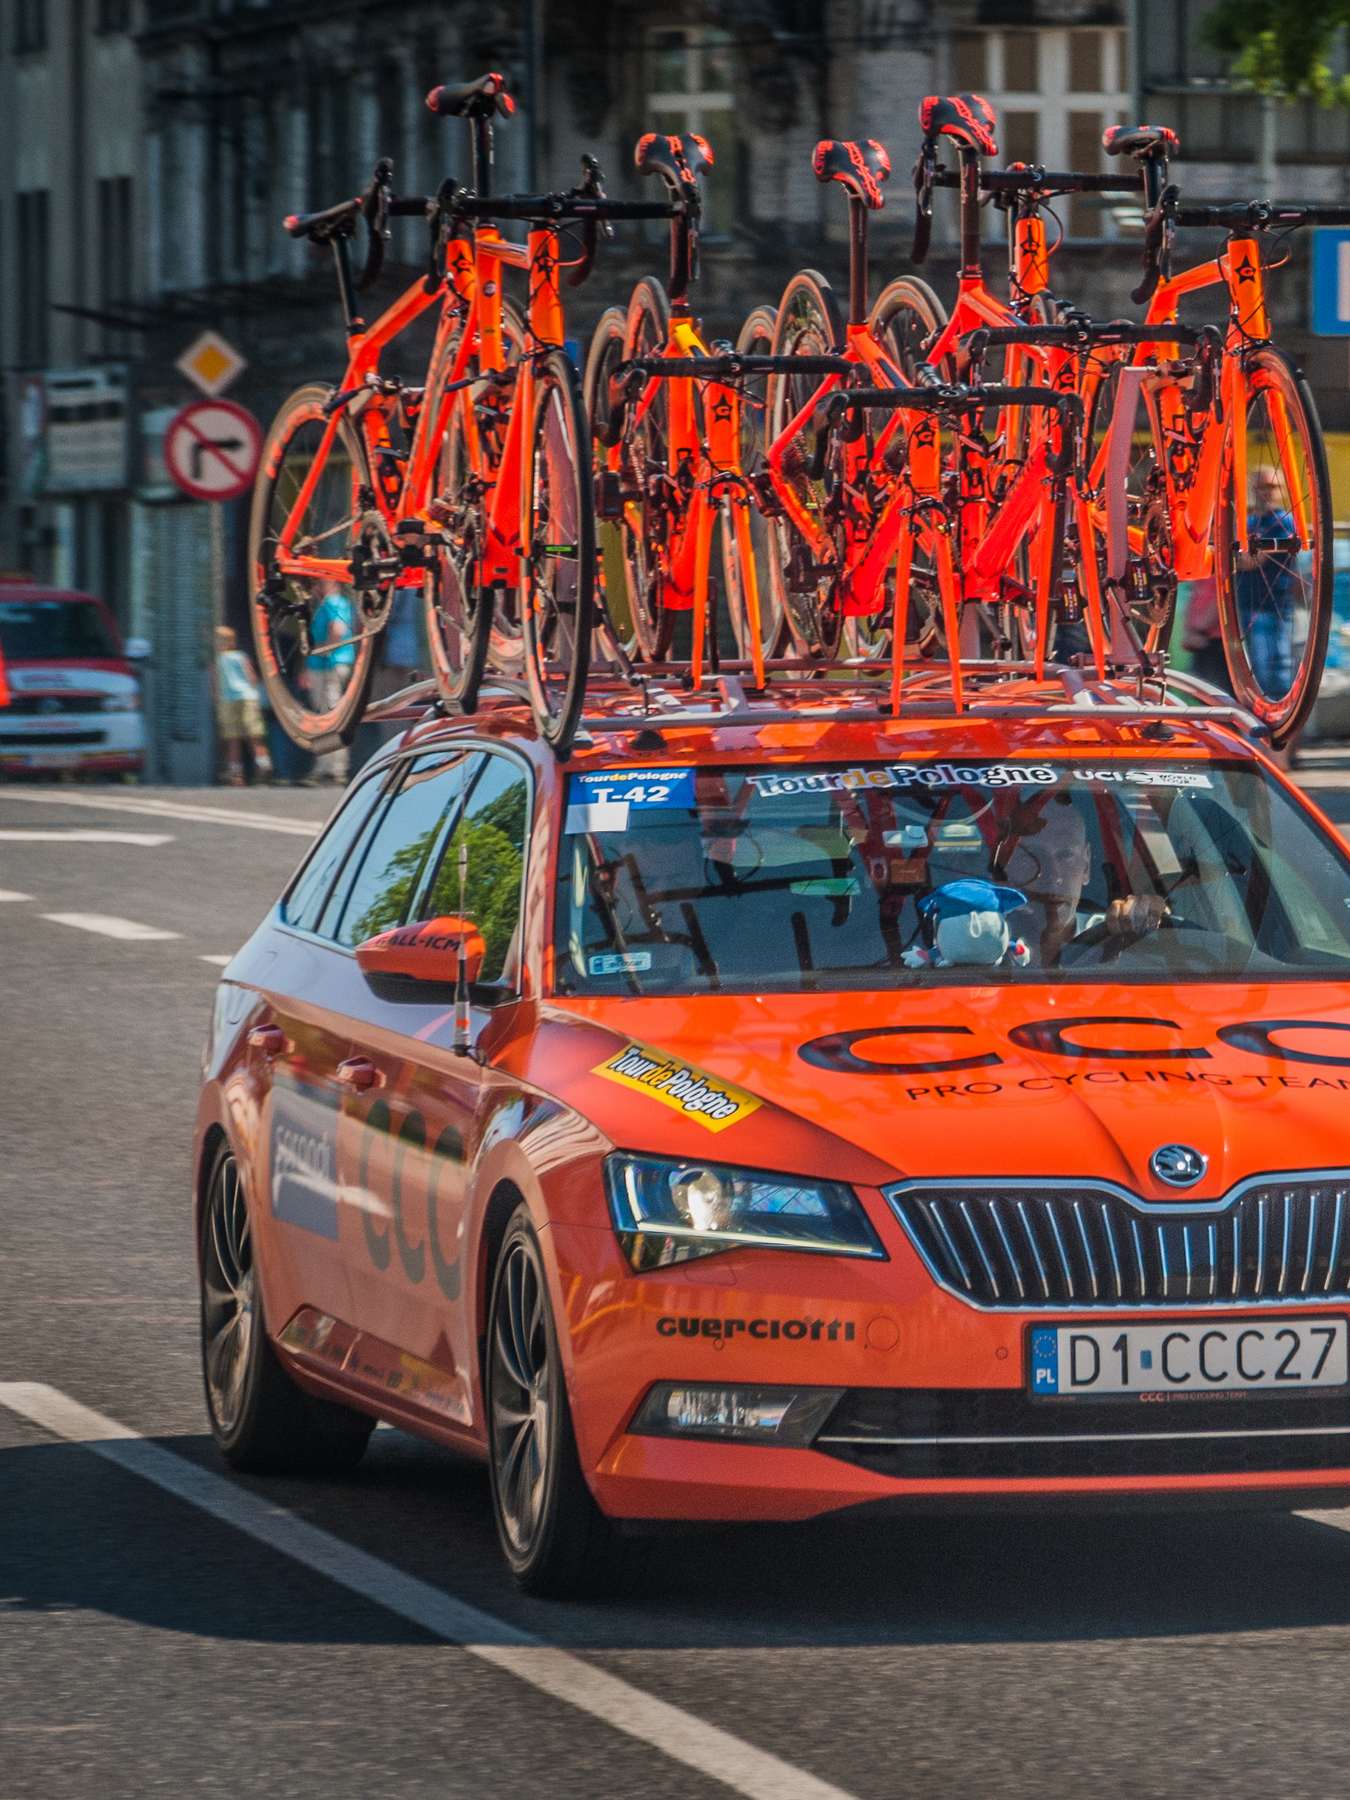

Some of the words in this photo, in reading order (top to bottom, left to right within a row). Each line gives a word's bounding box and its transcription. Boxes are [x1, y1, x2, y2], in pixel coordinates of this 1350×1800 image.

[578, 771, 687, 783] TourdePologne
[744, 764, 1057, 797] TourdePologne
[1072, 769, 1124, 782] UCI
[592, 785, 670, 803] T-42
[607, 1045, 739, 1119] TourdePologne
[904, 1081, 1004, 1101] PRO
[1018, 1070, 1237, 1091] CYCLING
[1070, 1333, 1129, 1386] D1
[1161, 1327, 1337, 1384] CCC27
[1035, 1369, 1055, 1384] PL
